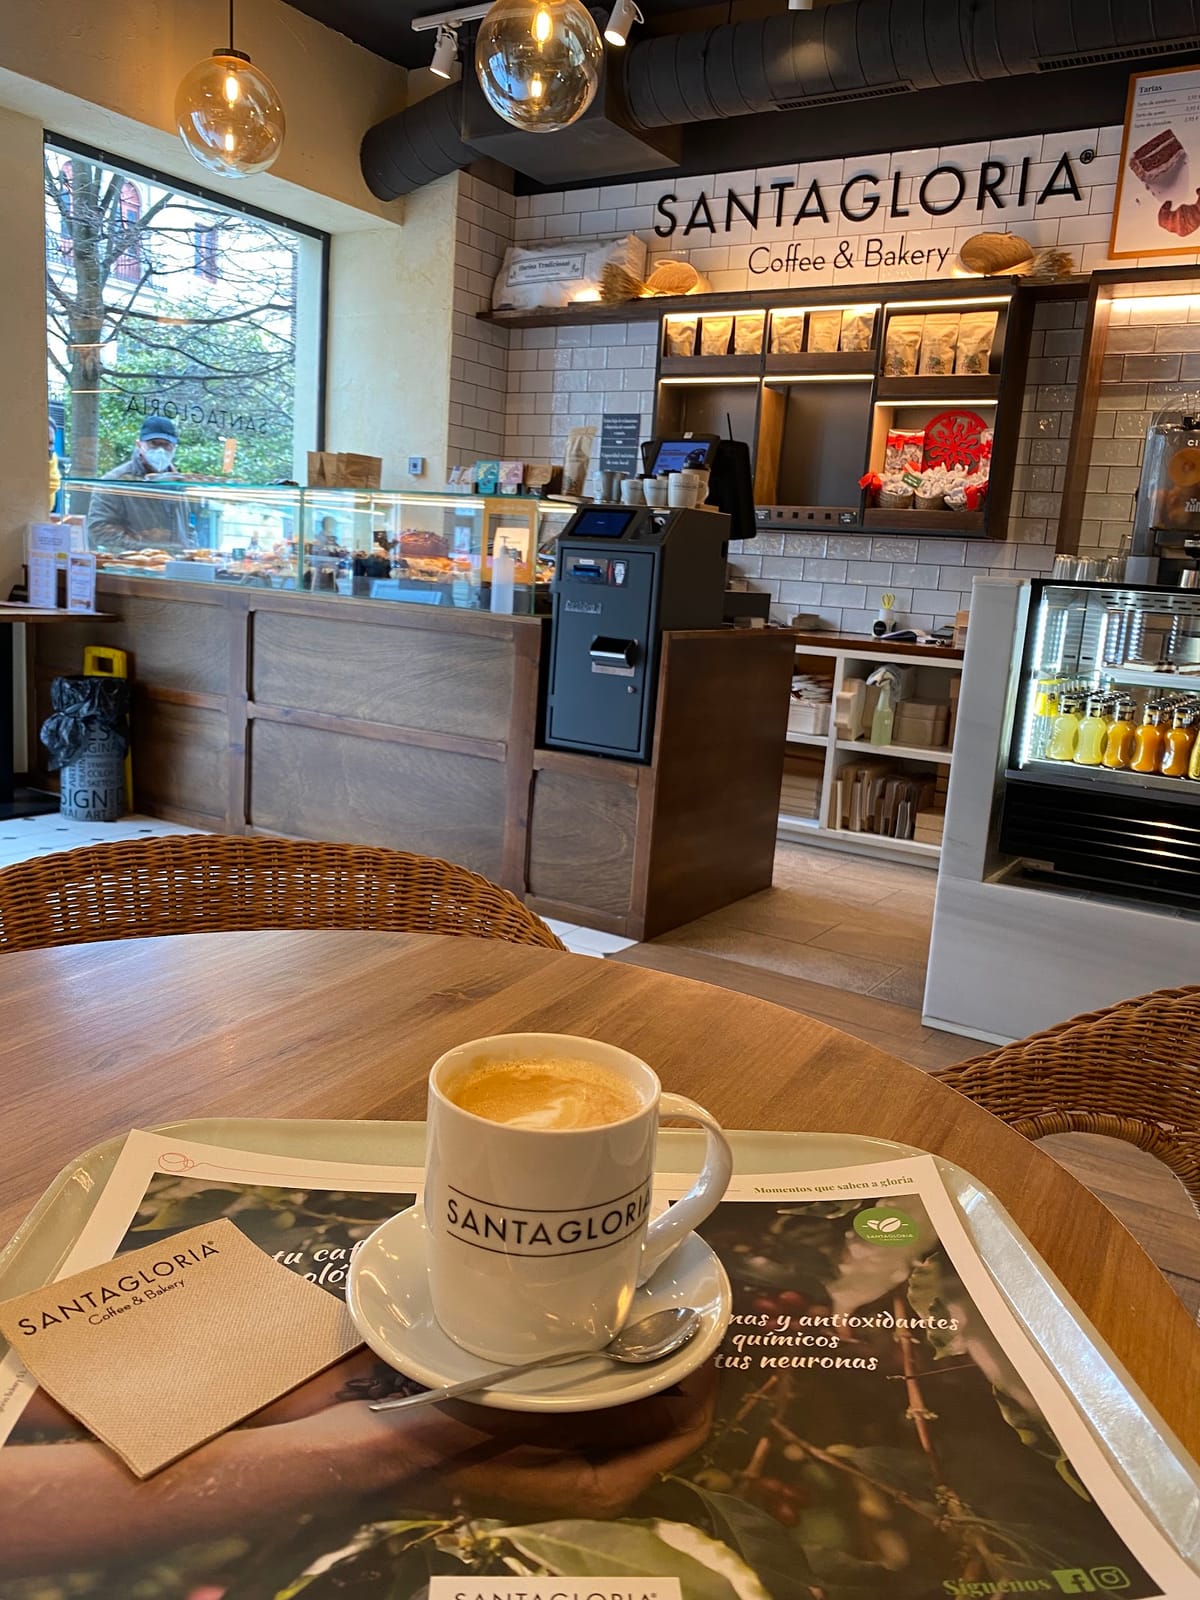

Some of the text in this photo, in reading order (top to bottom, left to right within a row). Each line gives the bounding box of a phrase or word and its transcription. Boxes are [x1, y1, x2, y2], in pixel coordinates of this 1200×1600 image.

[1139, 85, 1162, 93] Tartas
[748, 234, 951, 275] Coffee & Bakery
[753, 1186, 812, 1195] Momentos
[814, 1184, 835, 1193] que
[837, 1181, 869, 1191] saben
[880, 1175, 914, 1188] gloria
[313, 1240, 366, 1263] caf
[88, 1279, 186, 1327] Coffee & Bakery
[776, 1314, 792, 1333] y
[799, 1310, 960, 1331] antioxidantes
[732, 1331, 840, 1353] químicos
[713, 1353, 879, 1371] tus neuronas
